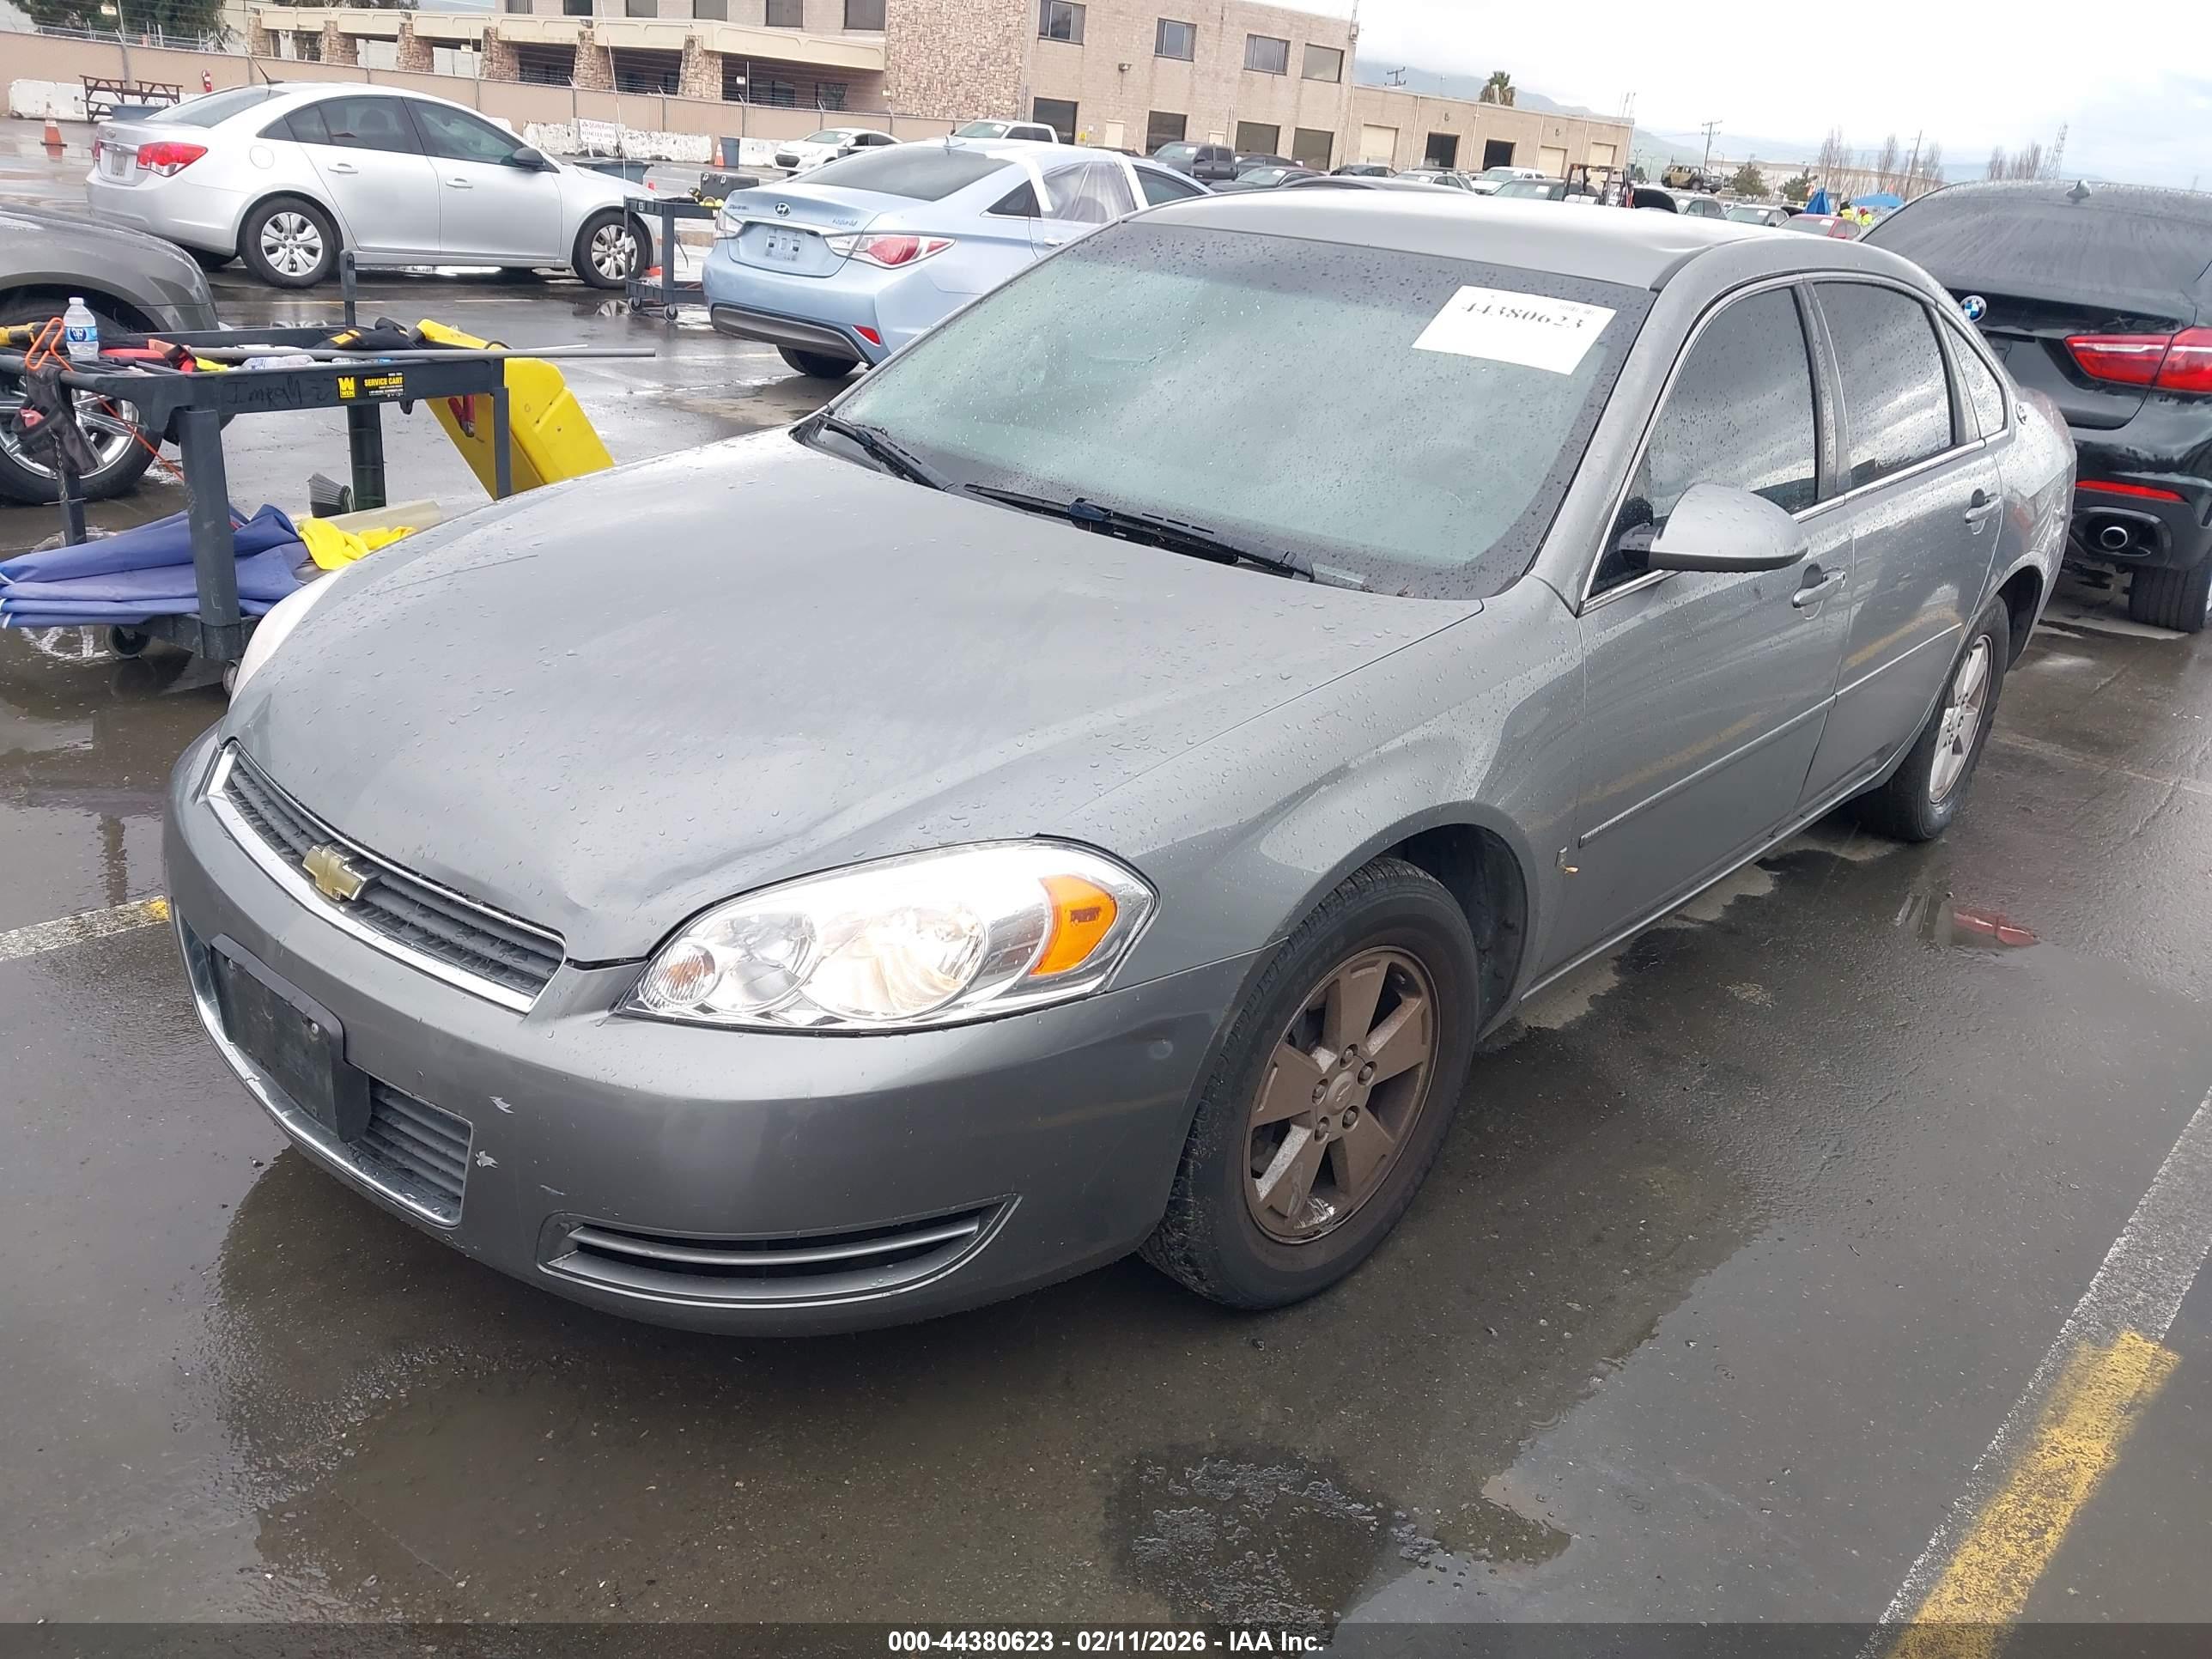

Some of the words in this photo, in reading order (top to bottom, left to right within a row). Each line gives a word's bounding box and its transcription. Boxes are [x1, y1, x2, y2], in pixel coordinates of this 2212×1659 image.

[1461, 302, 1584, 329] 44380623
[363, 378, 388, 387] SERVICE
[388, 376, 404, 385] CART
